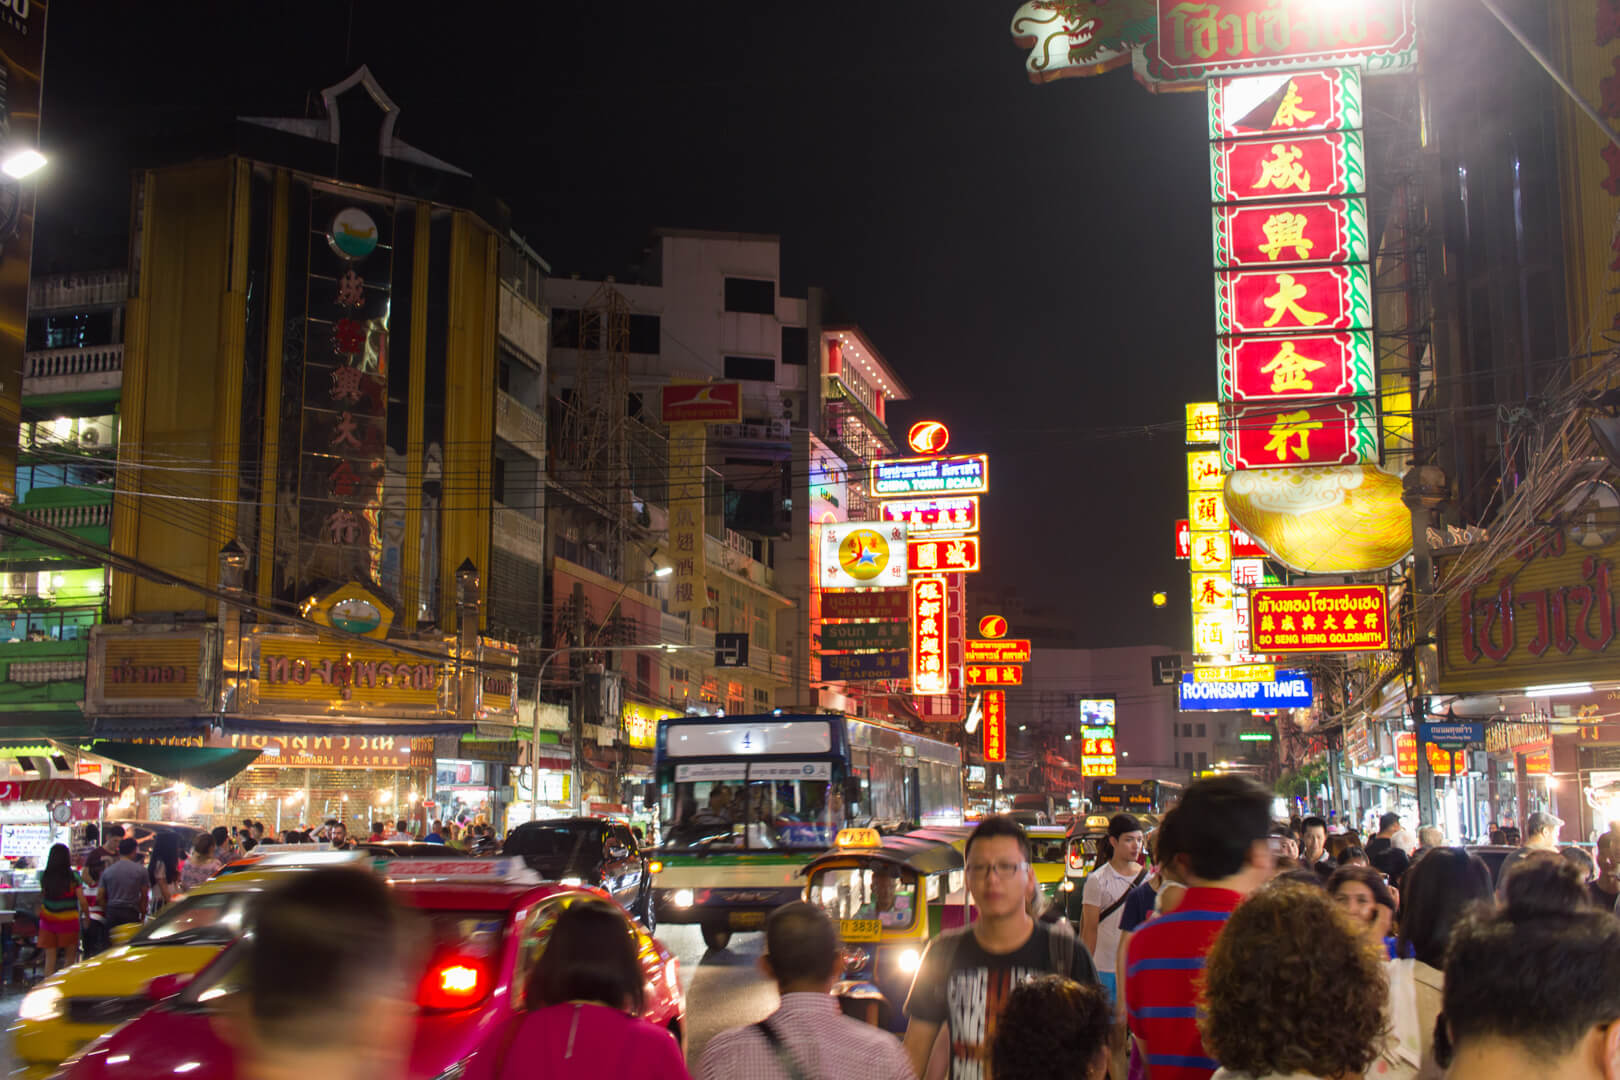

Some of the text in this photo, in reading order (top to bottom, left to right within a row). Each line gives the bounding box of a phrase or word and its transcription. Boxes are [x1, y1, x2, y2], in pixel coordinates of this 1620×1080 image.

[876, 476, 983, 492] CHINA TOWN SCALA
[1259, 632, 1382, 645] SO SENG HENG GOLDSMITH
[1183, 680, 1310, 700] ROONGSARP TRAVEL
[842, 831, 871, 842] TAXI
